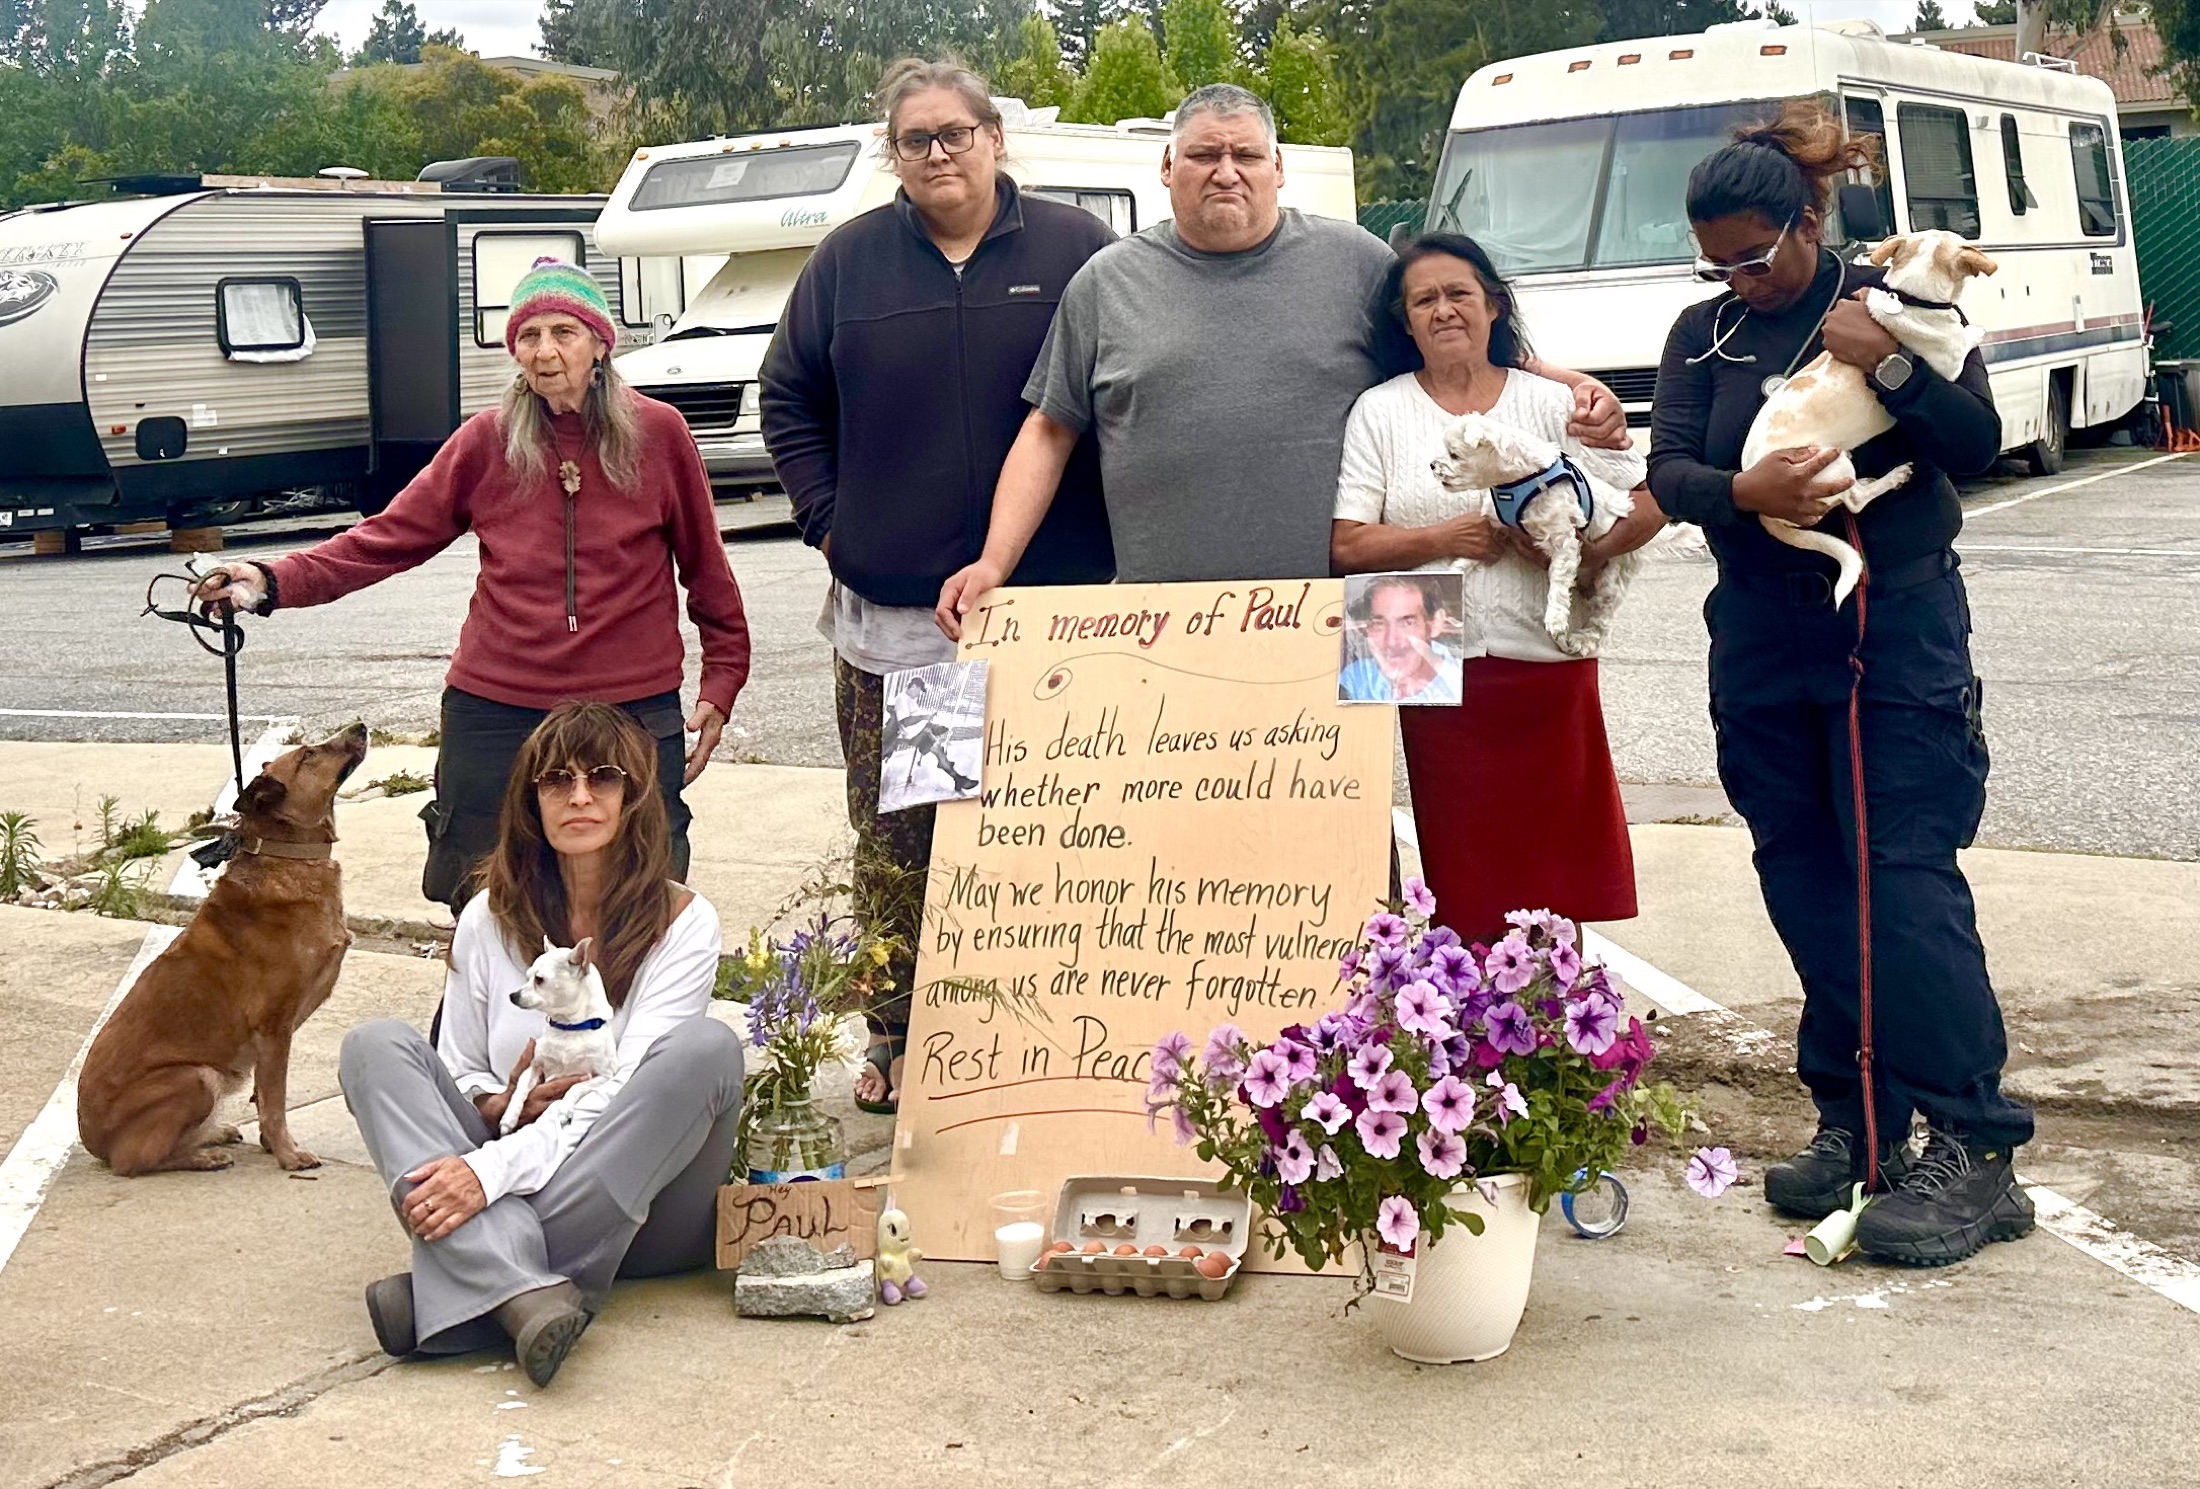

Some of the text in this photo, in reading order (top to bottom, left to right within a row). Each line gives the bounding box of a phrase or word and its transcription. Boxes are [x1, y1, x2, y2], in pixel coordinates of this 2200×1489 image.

[780, 207, 829, 227] Ultra
[965, 582, 1311, 650] In memory of Paul
[985, 693, 1341, 766] His death leaves us asking
[979, 757, 1361, 809] whether more could have
[977, 806, 1133, 850] been done.
[945, 855, 1332, 928] May we honor his memory
[936, 906, 1367, 970] by ensuring that the most vulnerab
[925, 975, 998, 1025] among
[1012, 972, 1039, 999] us
[1050, 969, 1090, 997] are
[1101, 968, 1172, 1002] never
[921, 1014, 1152, 1086] Rest in Peac
[768, 1184, 792, 1199] Hey
[725, 1195, 849, 1246] PAUL
